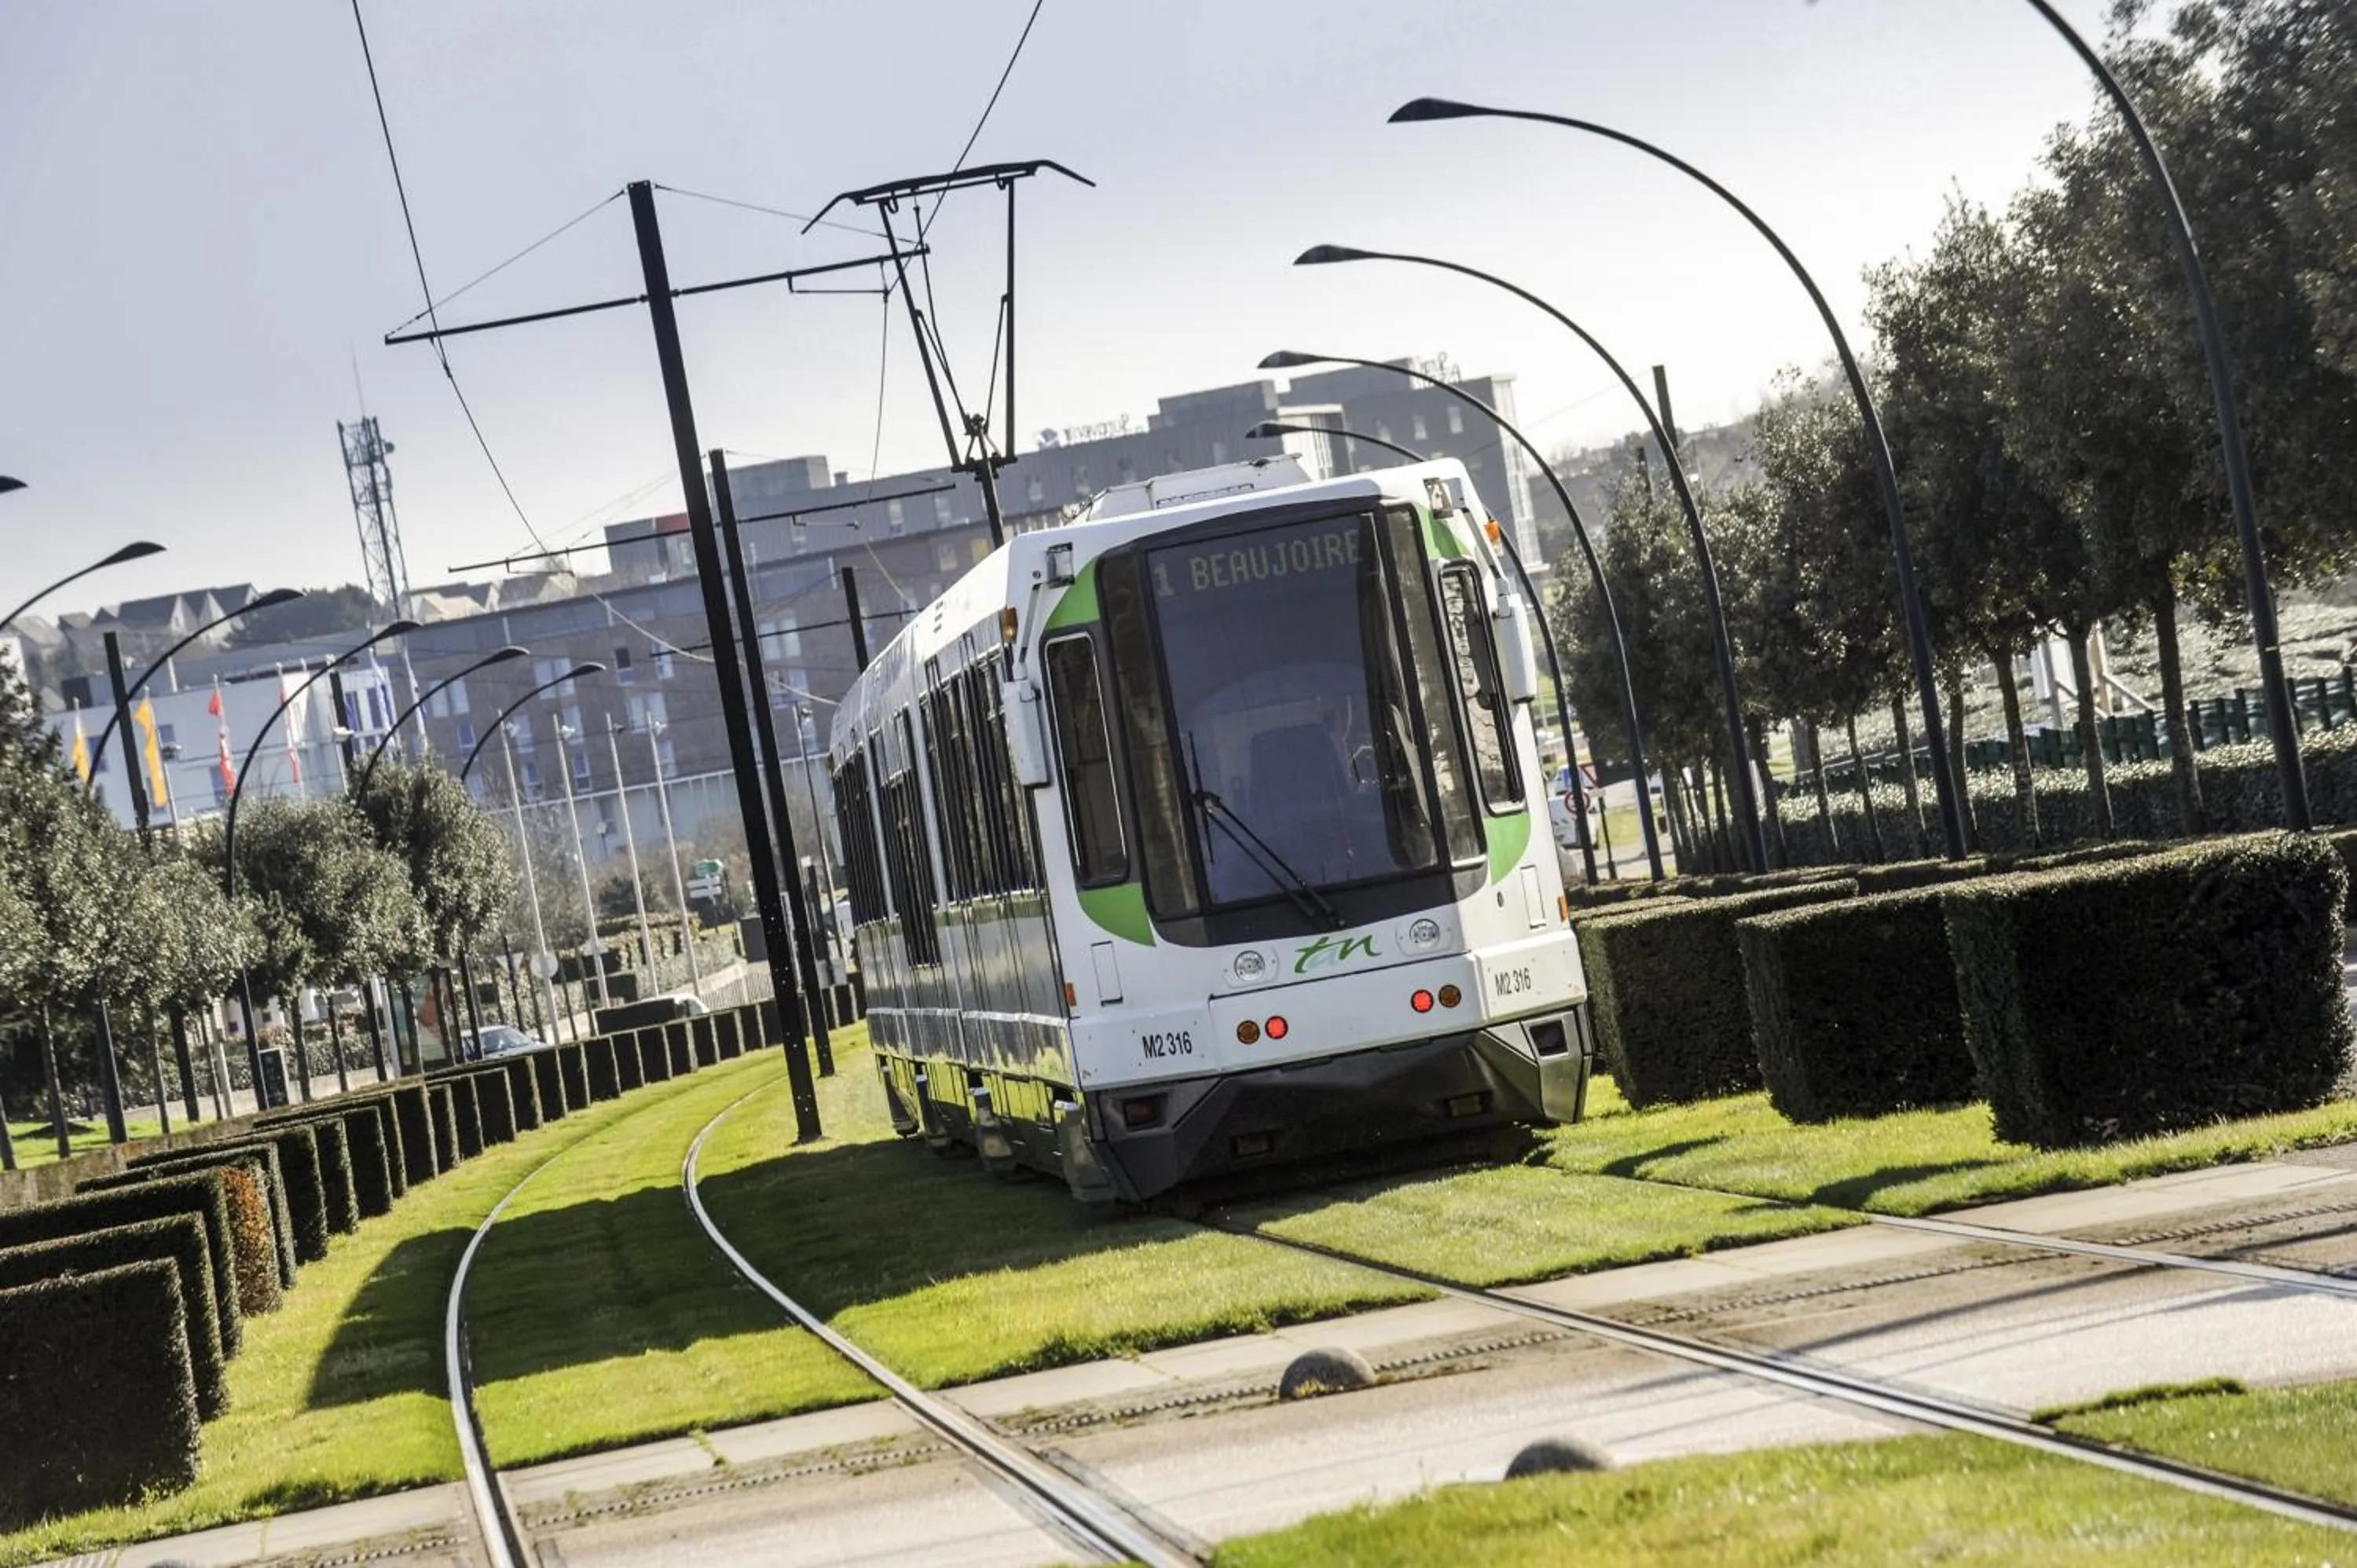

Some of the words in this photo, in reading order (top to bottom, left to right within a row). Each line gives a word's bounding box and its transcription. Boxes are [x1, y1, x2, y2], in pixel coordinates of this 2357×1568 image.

[1153, 563, 1175, 598] 1
[1189, 529, 1363, 591] BEAUJOIRE
[1495, 971, 1512, 997] M2
[1512, 967, 1531, 992] 316
[1142, 1034, 1166, 1059] M2
[1167, 1031, 1192, 1056] 316
